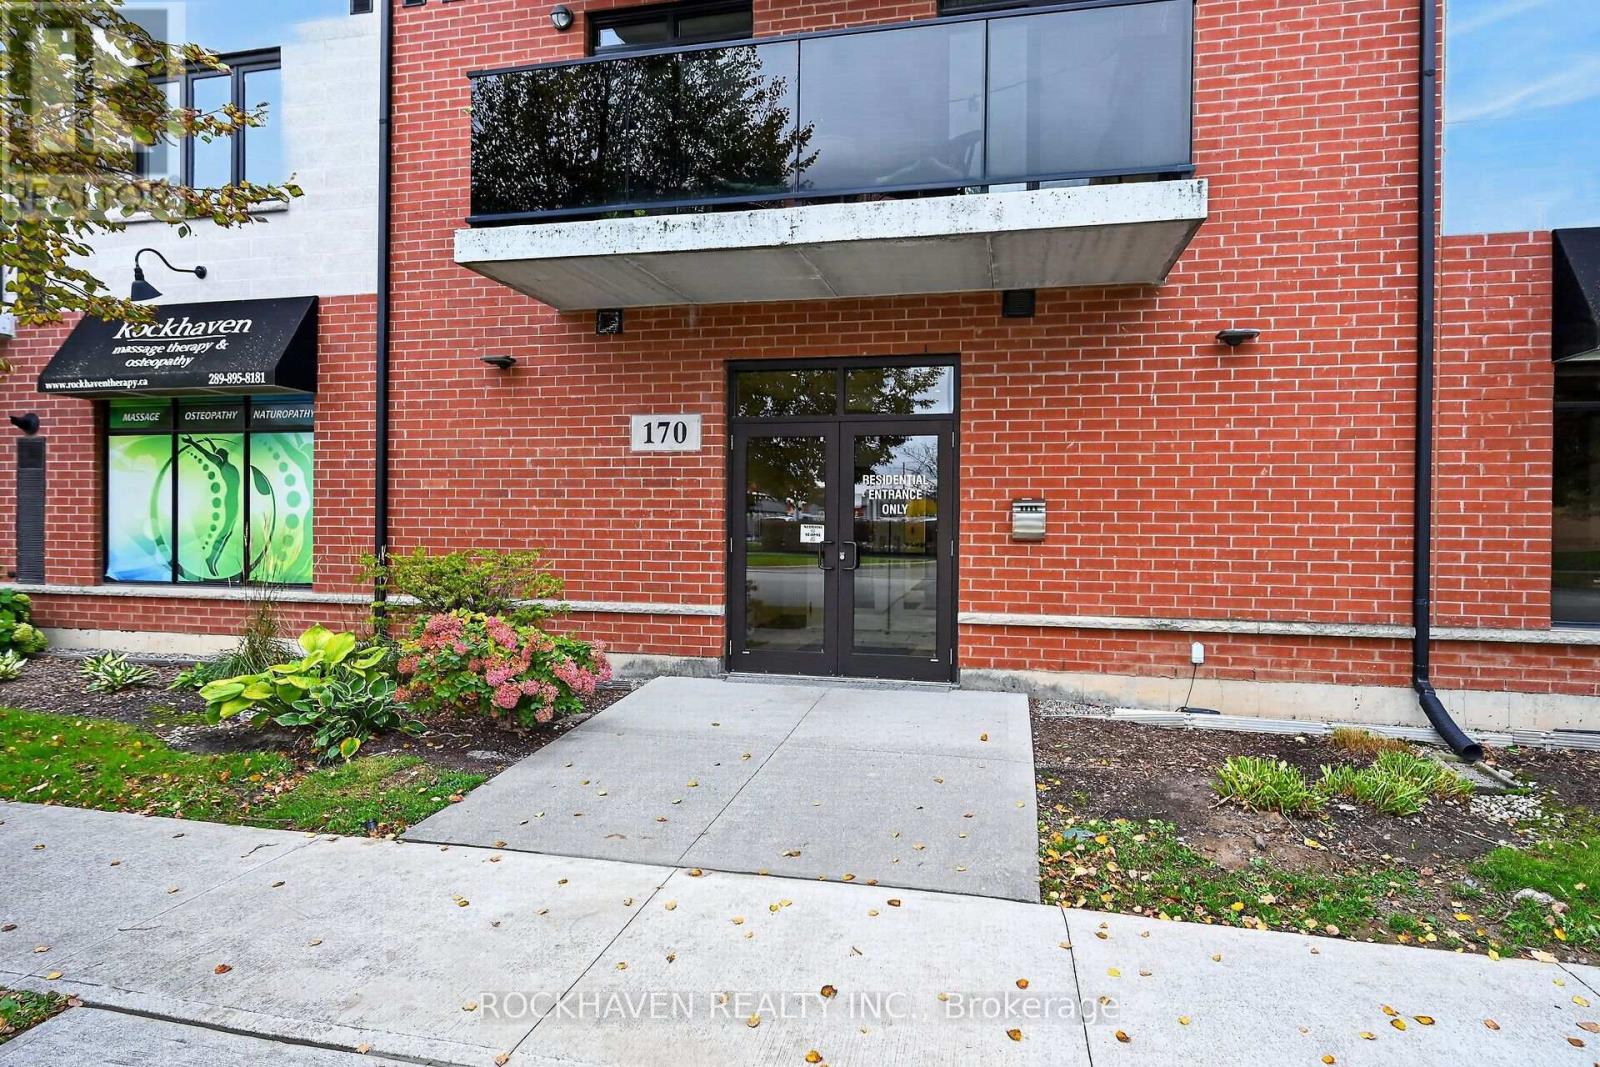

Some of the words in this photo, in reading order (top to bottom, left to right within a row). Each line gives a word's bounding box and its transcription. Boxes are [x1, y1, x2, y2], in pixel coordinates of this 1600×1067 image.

[112, 344, 165, 356] massage
[166, 342, 214, 355] therapy
[215, 339, 229, 350] &
[125, 355, 195, 369] osteopathy
[45, 378, 148, 389] www.rockhaventherapy.ca
[208, 372, 266, 385] 289-895-8181
[122, 412, 160, 422] MASSAGE
[184, 410, 238, 420] OSTEOPATHY
[253, 409, 314, 419] NATUROPATHY
[643, 421, 687, 443] 170
[862, 474, 928, 485] RESIDENTIAL
[868, 489, 922, 500] ENTRANCE
[882, 504, 909, 515] ONLY
